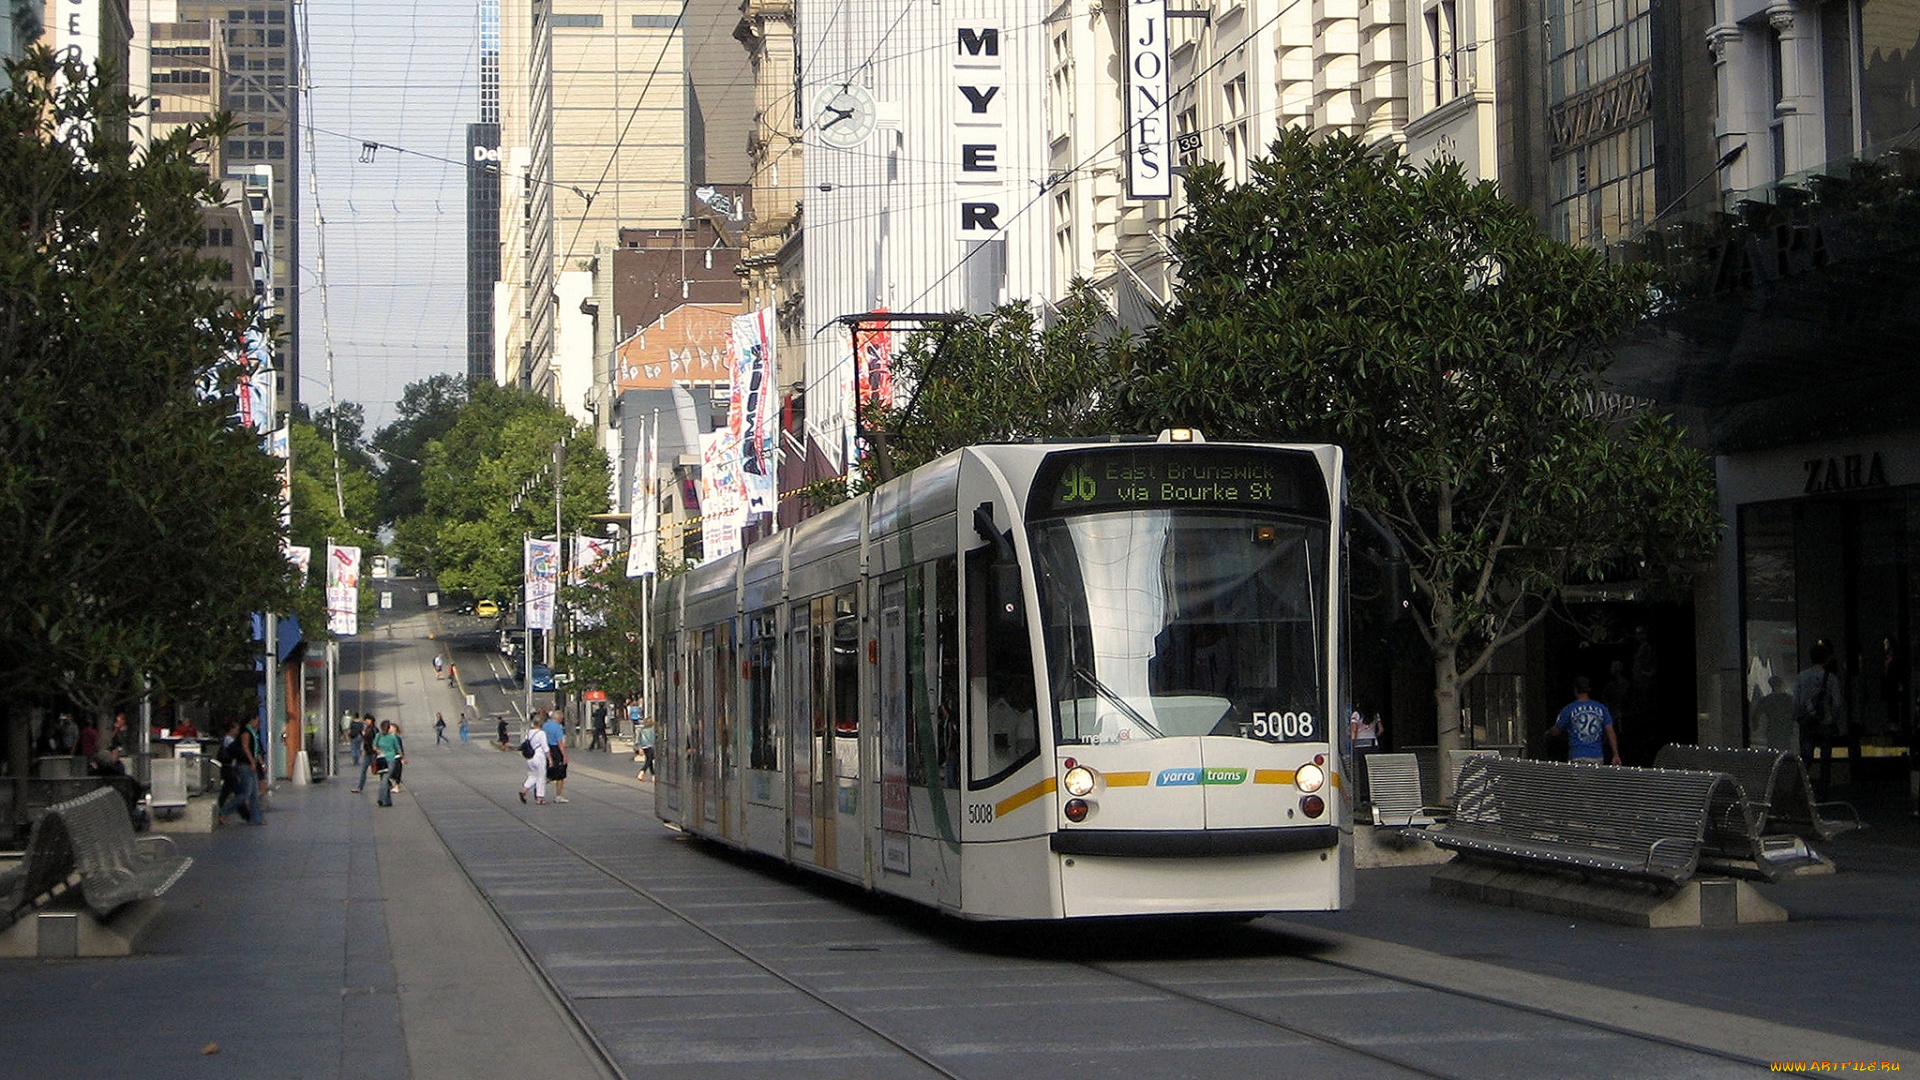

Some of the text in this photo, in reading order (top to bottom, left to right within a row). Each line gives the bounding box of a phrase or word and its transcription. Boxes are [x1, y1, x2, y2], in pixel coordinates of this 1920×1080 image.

[1134, 17, 1161, 180] JONES
[958, 28, 1000, 231] MYER
[1181, 135, 1200, 152] 39
[1060, 464, 1097, 501] 96
[1106, 463, 1275, 480] East Brunswick
[1804, 450, 1890, 493] ZARA
[1117, 482, 1273, 501] via Bourke St
[1252, 711, 1314, 737] 5008
[1162, 771, 1241, 784] yarra trams
[968, 804, 993, 823] 5008
